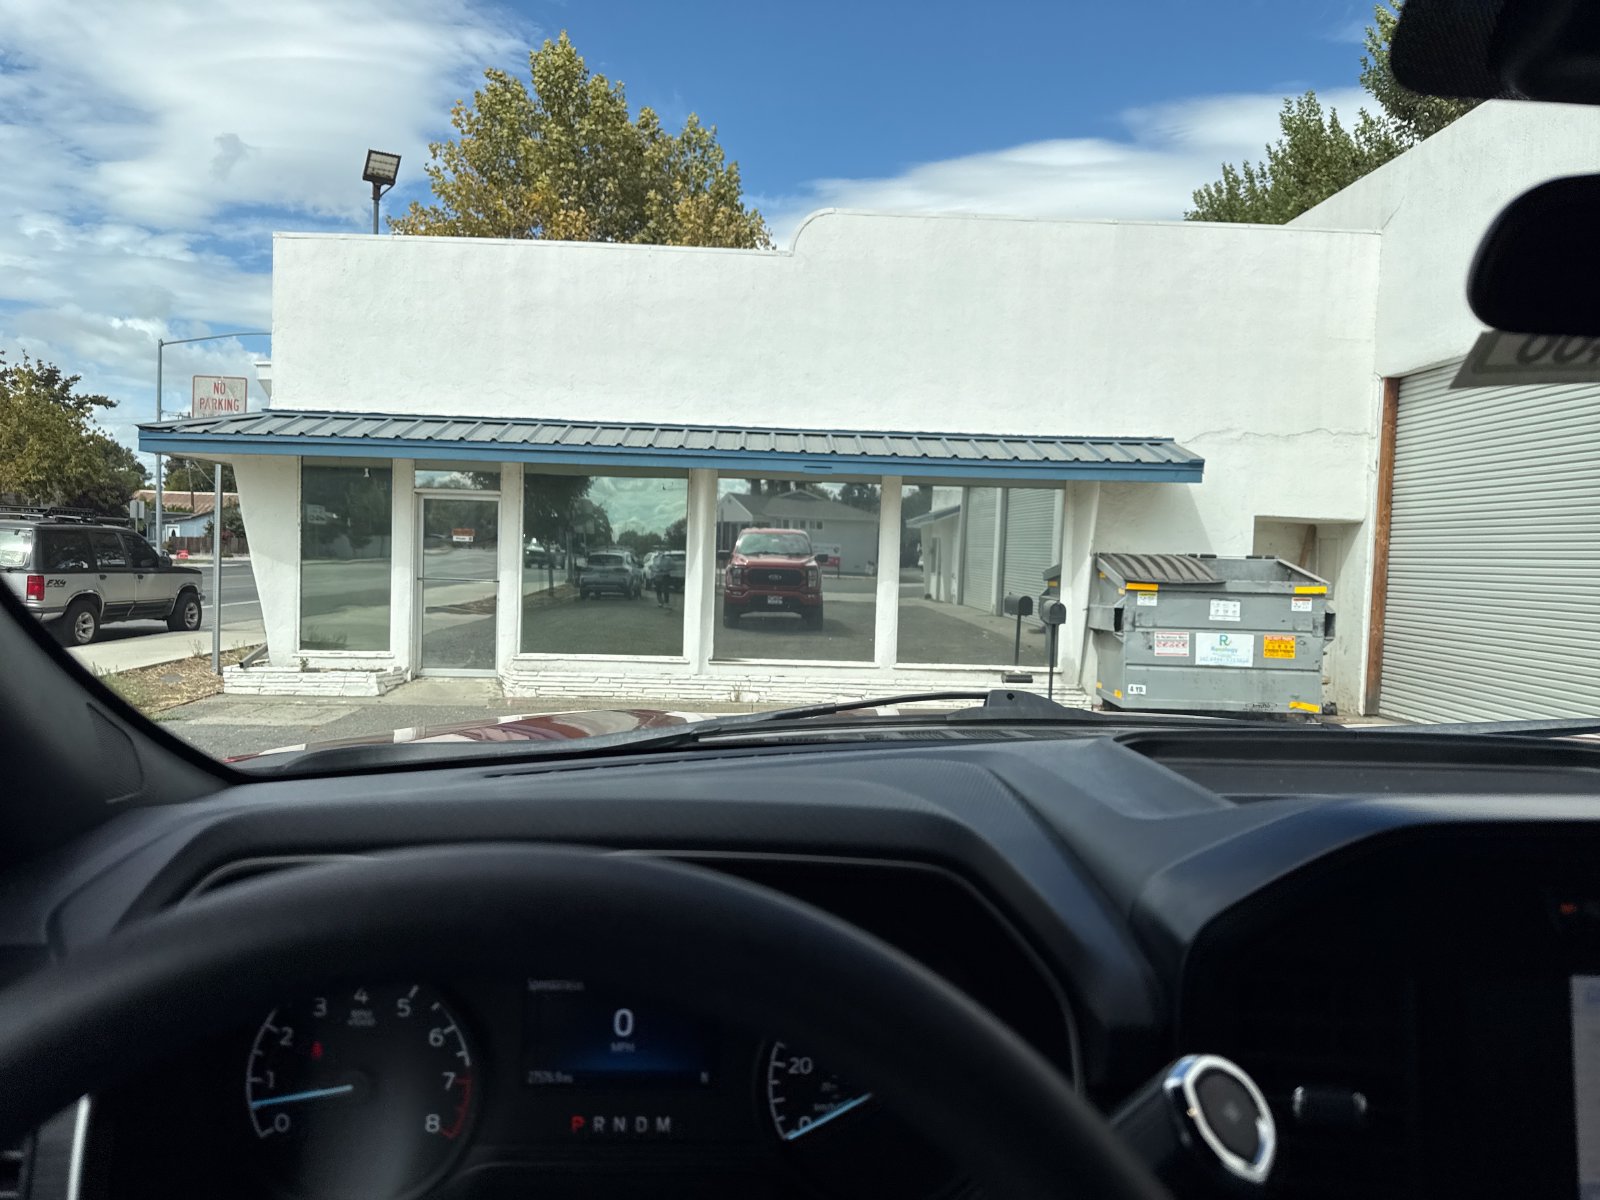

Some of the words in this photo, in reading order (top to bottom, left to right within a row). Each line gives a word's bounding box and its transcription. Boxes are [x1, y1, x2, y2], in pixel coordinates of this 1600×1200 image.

[213, 382, 226, 395] NO
[199, 397, 240, 412] PARKING
[46, 578, 67, 586] FX4
[354, 988, 369, 1005] 4
[313, 997, 327, 1017] 3
[397, 998, 411, 1018] 5
[613, 1007, 635, 1037] 0
[279, 1026, 293, 1046] 2
[428, 1027, 444, 1047] 6
[788, 1057, 813, 1074] 20
[266, 1071, 275, 1089] 1
[441, 1071, 456, 1090] 7
[274, 1112, 290, 1133] 0
[424, 1113, 440, 1133] 8
[570, 1114, 586, 1132] P
[592, 1116, 605, 1132] R
[613, 1116, 626, 1132] N
[635, 1116, 648, 1132] D
[656, 1116, 671, 1132] M
